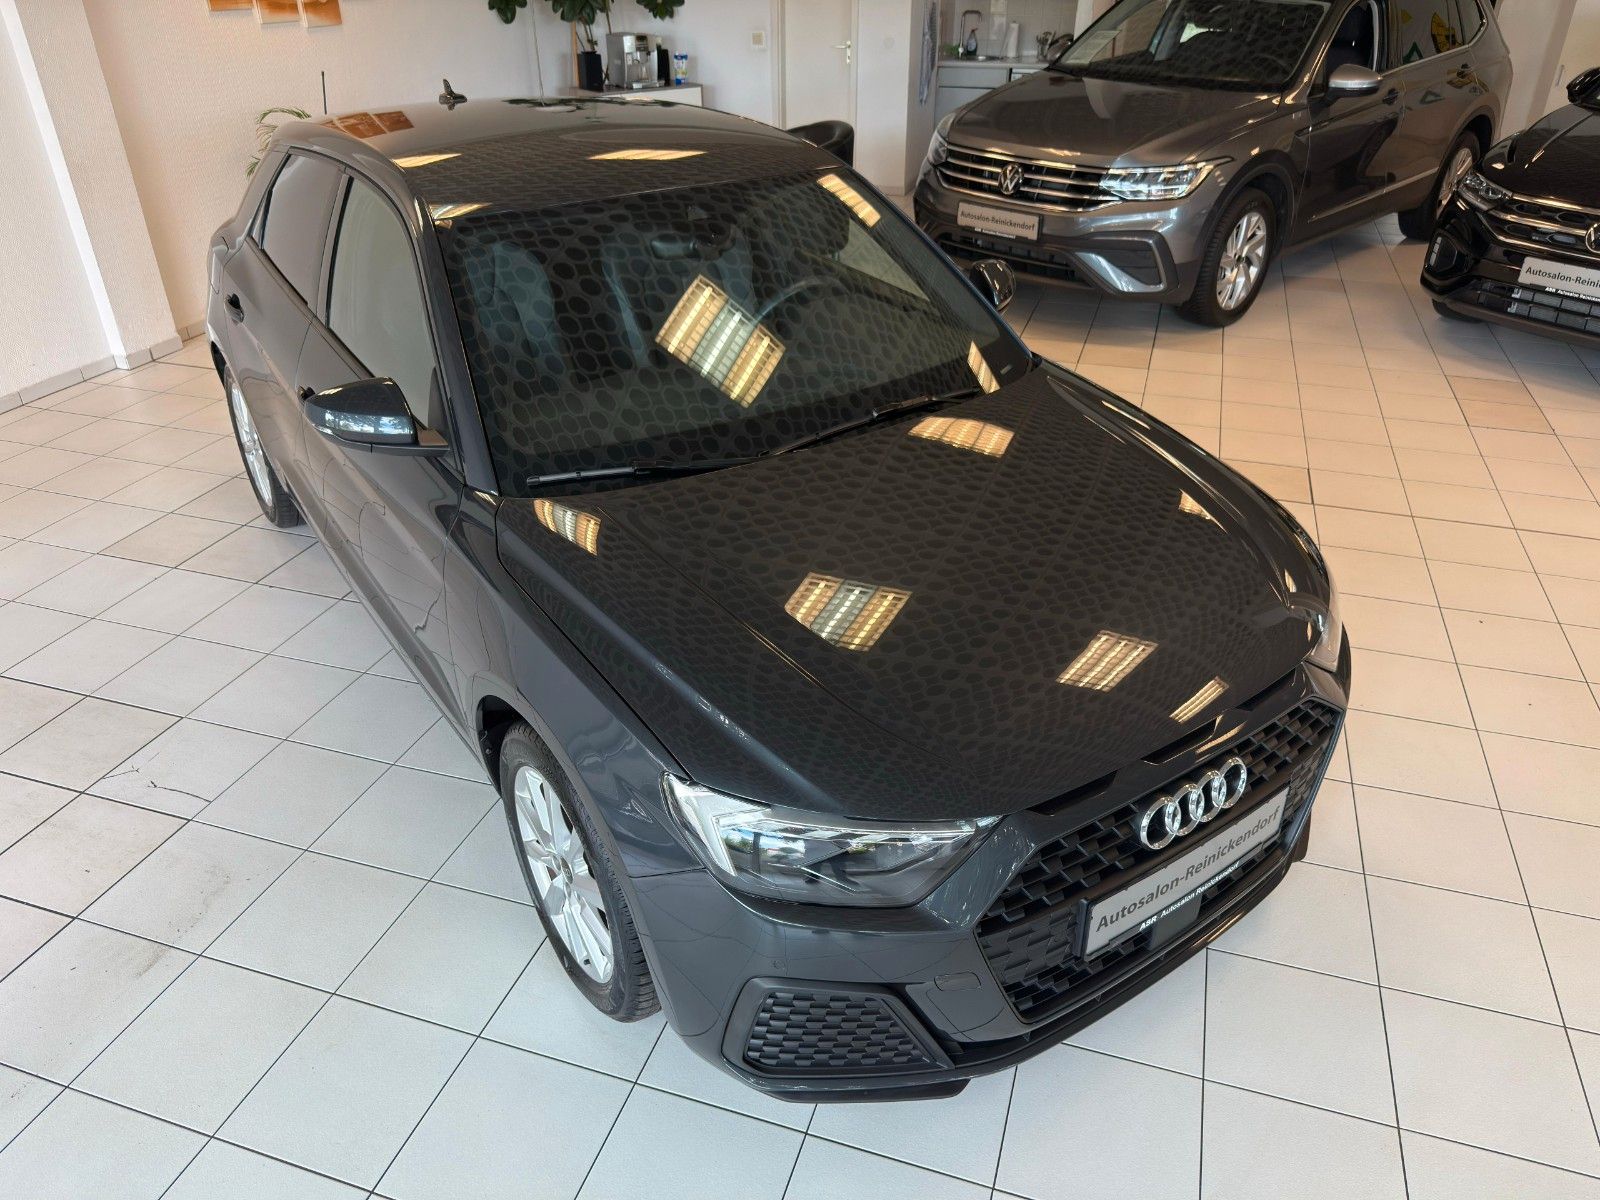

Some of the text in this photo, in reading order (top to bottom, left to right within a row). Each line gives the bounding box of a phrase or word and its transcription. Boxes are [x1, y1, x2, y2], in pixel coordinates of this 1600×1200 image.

[960, 210, 1035, 231] Autosalon-Reinickendorf
[1096, 805, 1280, 933] Autosalon-Reinickendorf
[1139, 915, 1158, 932] ASR
[1160, 892, 1195, 918] Autosalon
